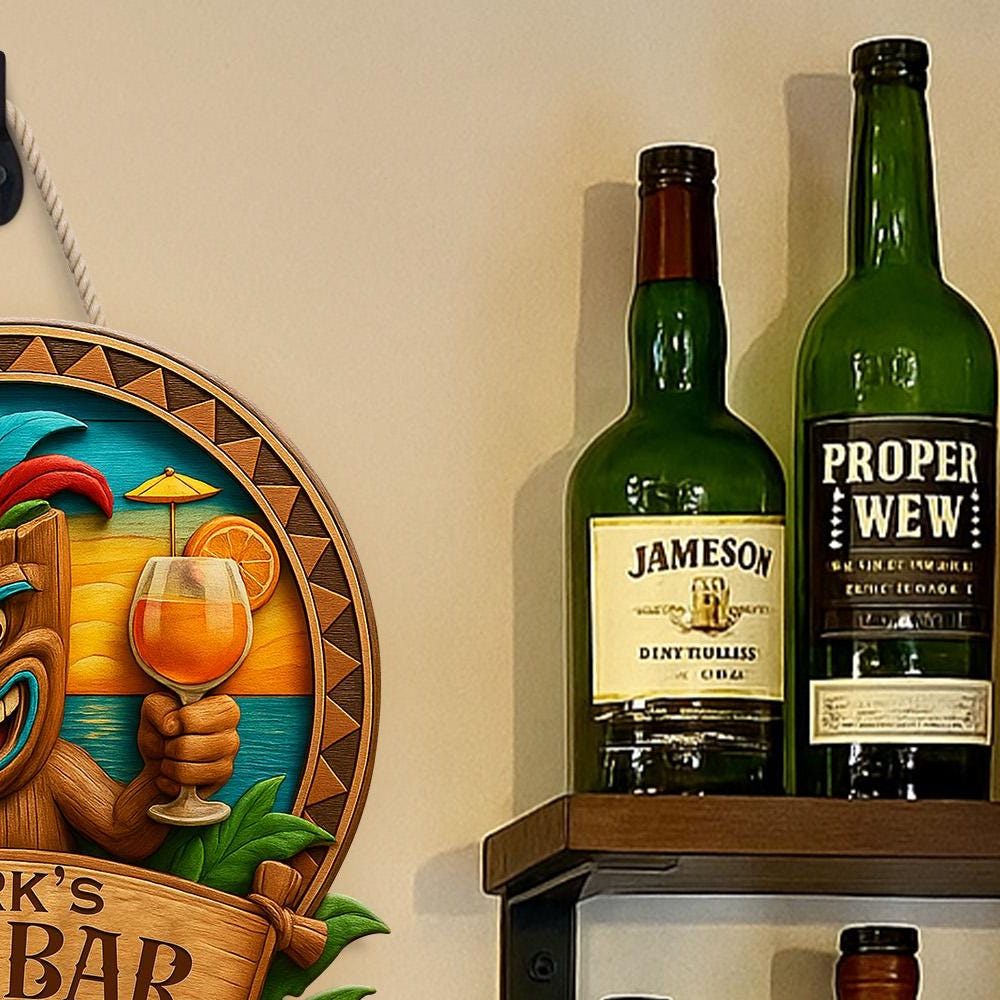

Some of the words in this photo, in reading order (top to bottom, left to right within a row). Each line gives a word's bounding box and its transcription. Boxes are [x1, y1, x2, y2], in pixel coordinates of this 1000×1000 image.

[822, 439, 978, 484] PROPER
[853, 493, 964, 540] WEW
[628, 538, 772, 579] JAMESON
